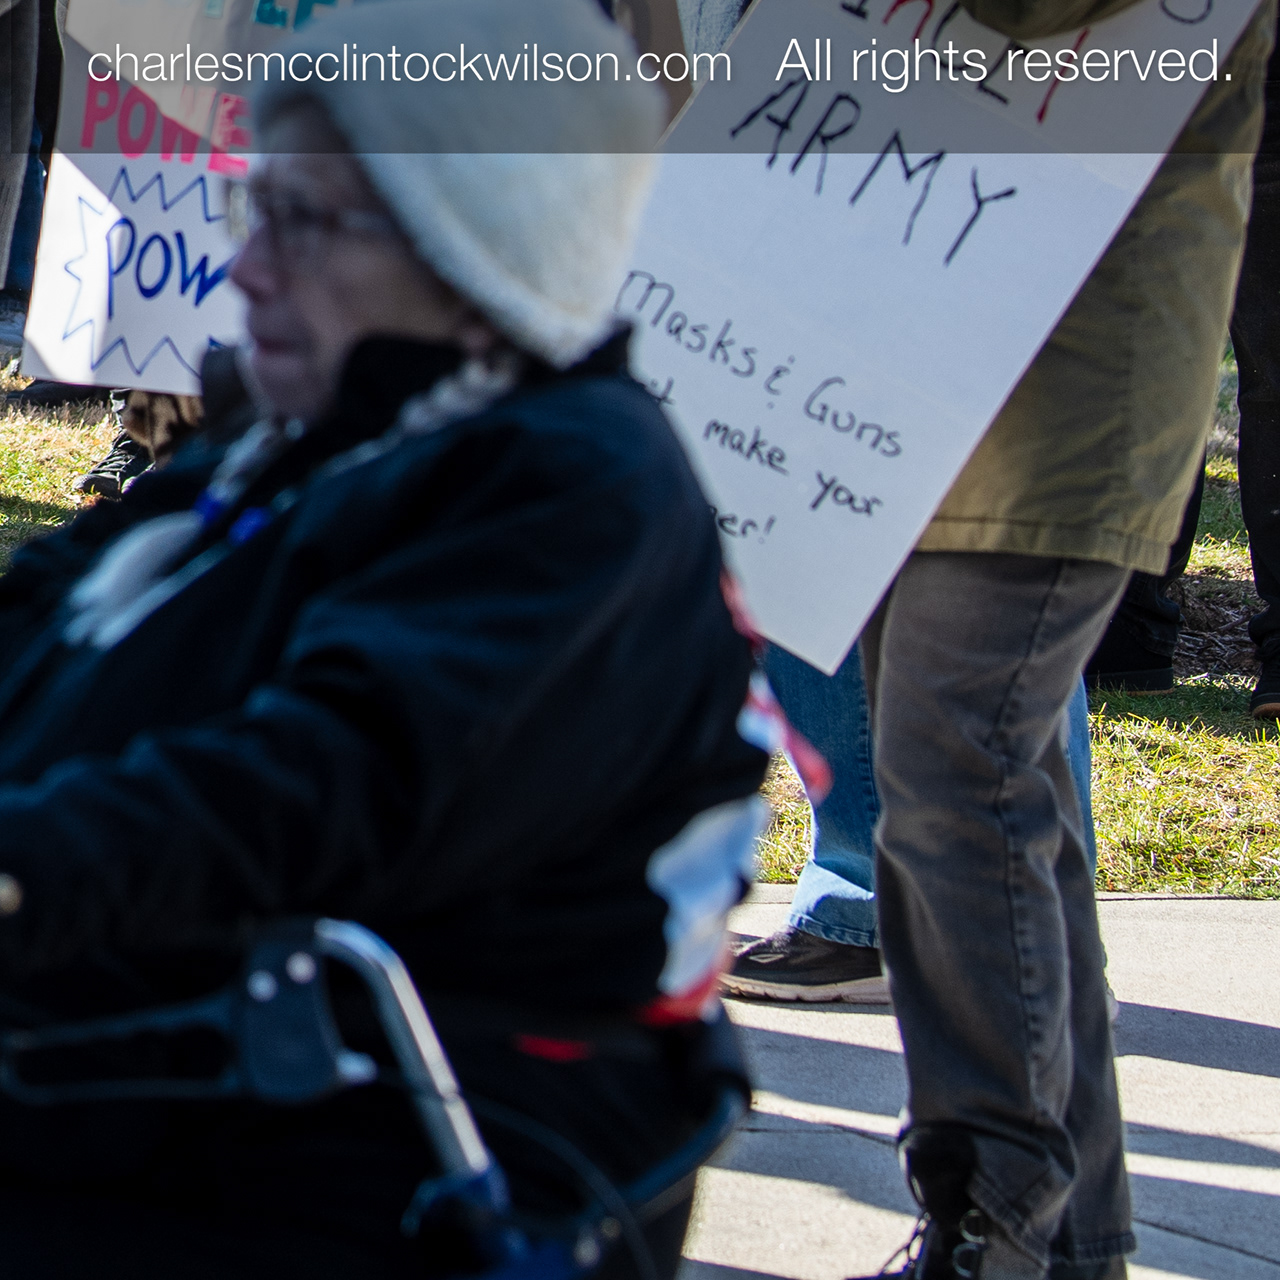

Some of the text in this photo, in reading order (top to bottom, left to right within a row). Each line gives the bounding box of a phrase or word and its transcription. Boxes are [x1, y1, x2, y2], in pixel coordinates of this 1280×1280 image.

[729, 70, 1018, 267] ARMY
[613, 269, 758, 378] Masks
[804, 375, 903, 459] Guns
[702, 419, 884, 517] make your
